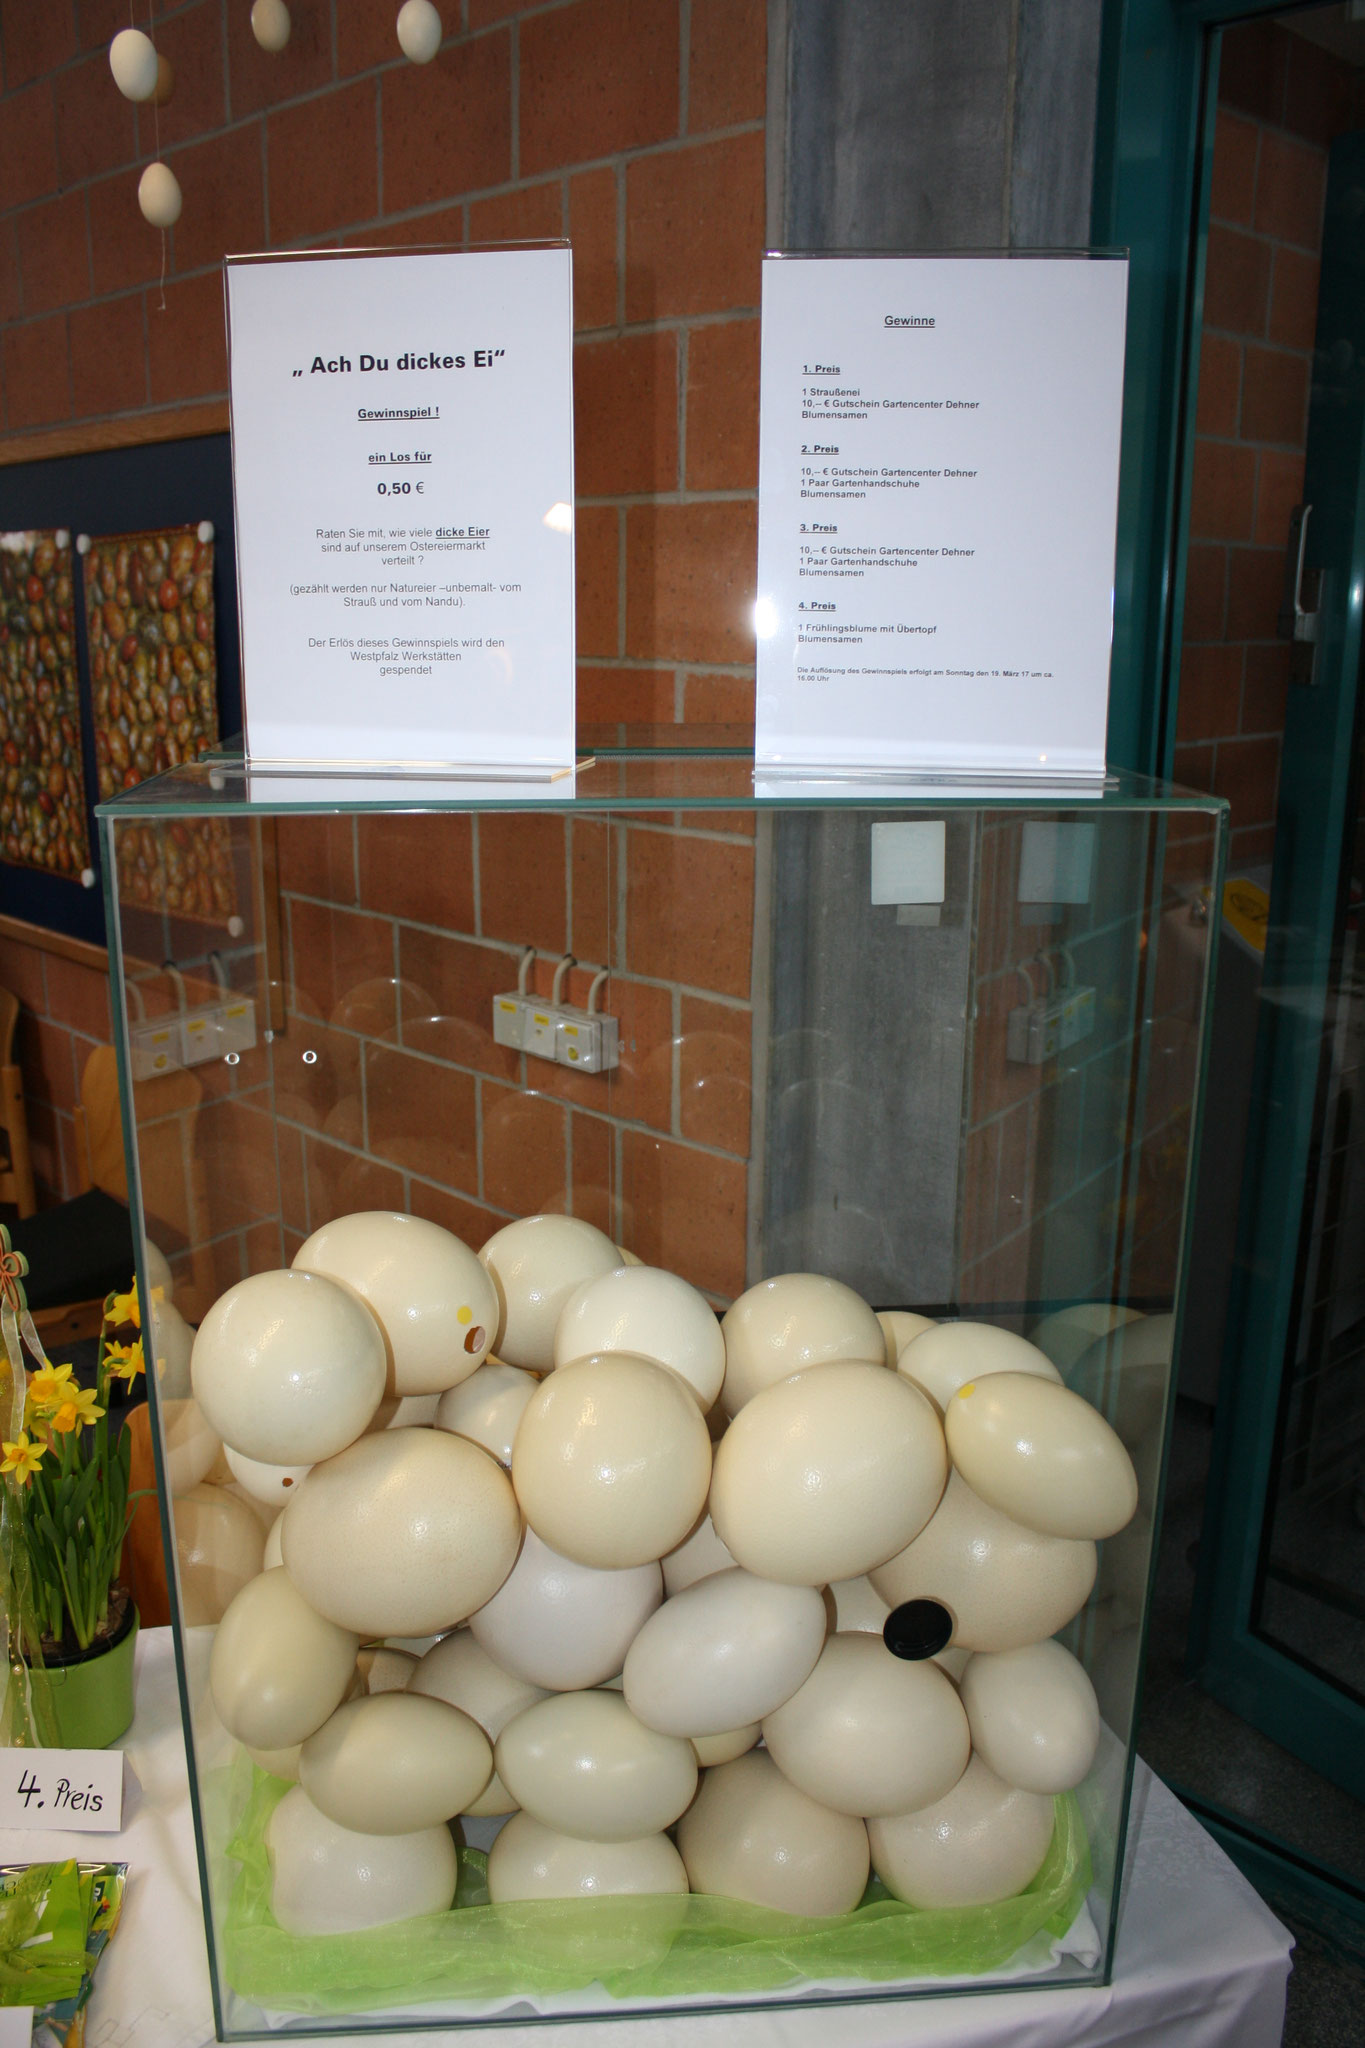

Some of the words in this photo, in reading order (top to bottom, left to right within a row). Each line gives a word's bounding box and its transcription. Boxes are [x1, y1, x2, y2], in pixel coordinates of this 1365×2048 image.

[884, 315, 936, 327] Gewinne
[310, 356, 352, 374] Ach
[359, 354, 389, 372] Du
[396, 352, 466, 371] dickes
[803, 365, 812, 373] 1.
[815, 365, 841, 373] Preis
[802, 388, 807, 396] 1
[810, 388, 860, 396] Straußenei
[824, 399, 830, 408] €
[832, 400, 880, 408] Gutschein
[882, 400, 943, 409] Gartencenter
[946, 400, 980, 409] Dehner
[357, 407, 431, 420] Gewinnspiel
[802, 411, 868, 419] Blumensamen
[801, 445, 811, 453] 2.
[813, 445, 839, 453] Preis
[368, 453, 386, 463] ein
[390, 452, 411, 463] Los
[414, 451, 432, 462] für
[823, 468, 829, 476] €
[831, 468, 879, 476] Gutschein
[881, 468, 941, 477] Gartencenter
[944, 469, 978, 477] Dehner
[801, 479, 805, 487] 1
[808, 479, 830, 487] Paar
[832, 479, 920, 488] Gartenhandschuhe
[377, 482, 411, 496] 0,50
[416, 482, 425, 494] €
[800, 490, 866, 499] Blumensamen
[316, 528, 347, 539] Raten
[349, 528, 365, 538] Sie
[368, 528, 386, 539] mit,
[389, 528, 406, 538] wie
[409, 527, 432, 537] viele
[435, 527, 465, 537] dicke
[468, 526, 490, 537] Eier
[800, 524, 809, 532] 3.
[812, 524, 838, 532] Preis
[321, 542, 341, 552] sind
[344, 541, 362, 552] auf
[363, 543, 407, 552] unserem
[410, 541, 486, 551] Ostereiermarkt
[821, 546, 827, 555] €
[830, 547, 877, 555] Gutschein
[879, 547, 939, 556] Gartencenter
[941, 547, 975, 556] Dehner
[381, 555, 415, 565] verteilt
[807, 558, 828, 566] Paar
[830, 558, 918, 566] Gartenhandschuhe
[799, 569, 864, 577] Blumensamen
[289, 584, 329, 596] (gezählt
[331, 583, 368, 594] werden
[370, 585, 387, 593] nur
[389, 583, 437, 593] Natureier
[499, 584, 522, 592] vom
[343, 597, 377, 607] Strauß
[379, 597, 398, 606] und
[401, 598, 422, 606] vom
[425, 596, 466, 608] Nandu).
[798, 602, 808, 610] 4.
[811, 602, 836, 610] Preis
[798, 624, 803, 632] 1
[806, 624, 877, 634] Frühlingsblume
[880, 625, 894, 633] mit
[897, 624, 937, 635] Übertopf
[308, 638, 326, 648] Der
[329, 638, 354, 648] Erlös
[356, 638, 389, 648] dieses
[391, 638, 459, 650] Gewinnspiels
[461, 638, 483, 648] wird
[485, 638, 505, 648] den
[798, 635, 863, 644] Blumensamen
[350, 651, 399, 663] Westpfalz
[401, 651, 462, 661] Werkstätten
[379, 665, 432, 677] gespendet
[810, 666, 846, 675] Auflösung
[861, 668, 908, 676] Gewinnspiels
[909, 669, 932, 677] erfolgt
[946, 669, 975, 678] Sonntag
[1002, 669, 1019, 677] März
[17, 1769, 45, 1809] 4.
[53, 1778, 104, 1812] Preis
